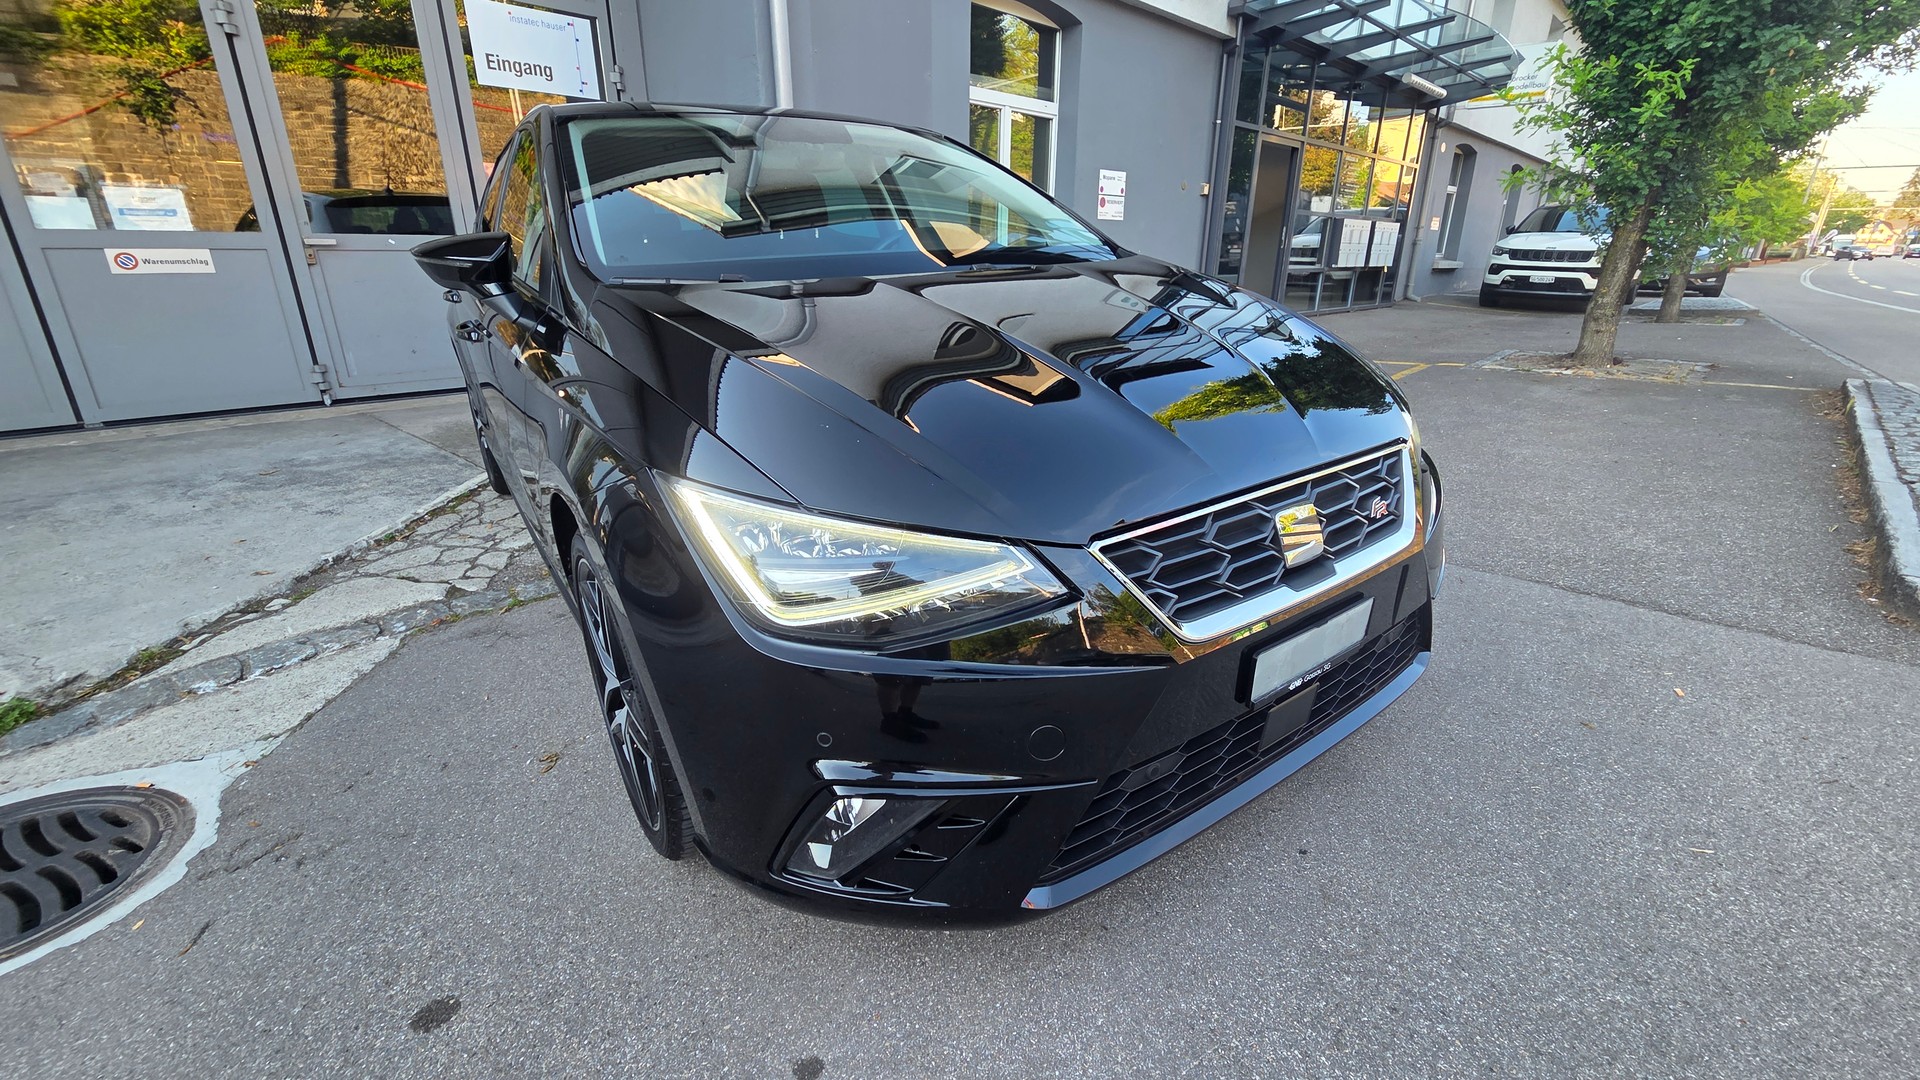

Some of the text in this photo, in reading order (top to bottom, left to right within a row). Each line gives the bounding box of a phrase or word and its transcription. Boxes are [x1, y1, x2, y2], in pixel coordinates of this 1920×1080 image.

[508, 12, 567, 32] instatec hauser
[485, 53, 554, 82] Eingang
[1513, 81, 1547, 91] odellbau
[141, 258, 209, 266] Warenumschlag
